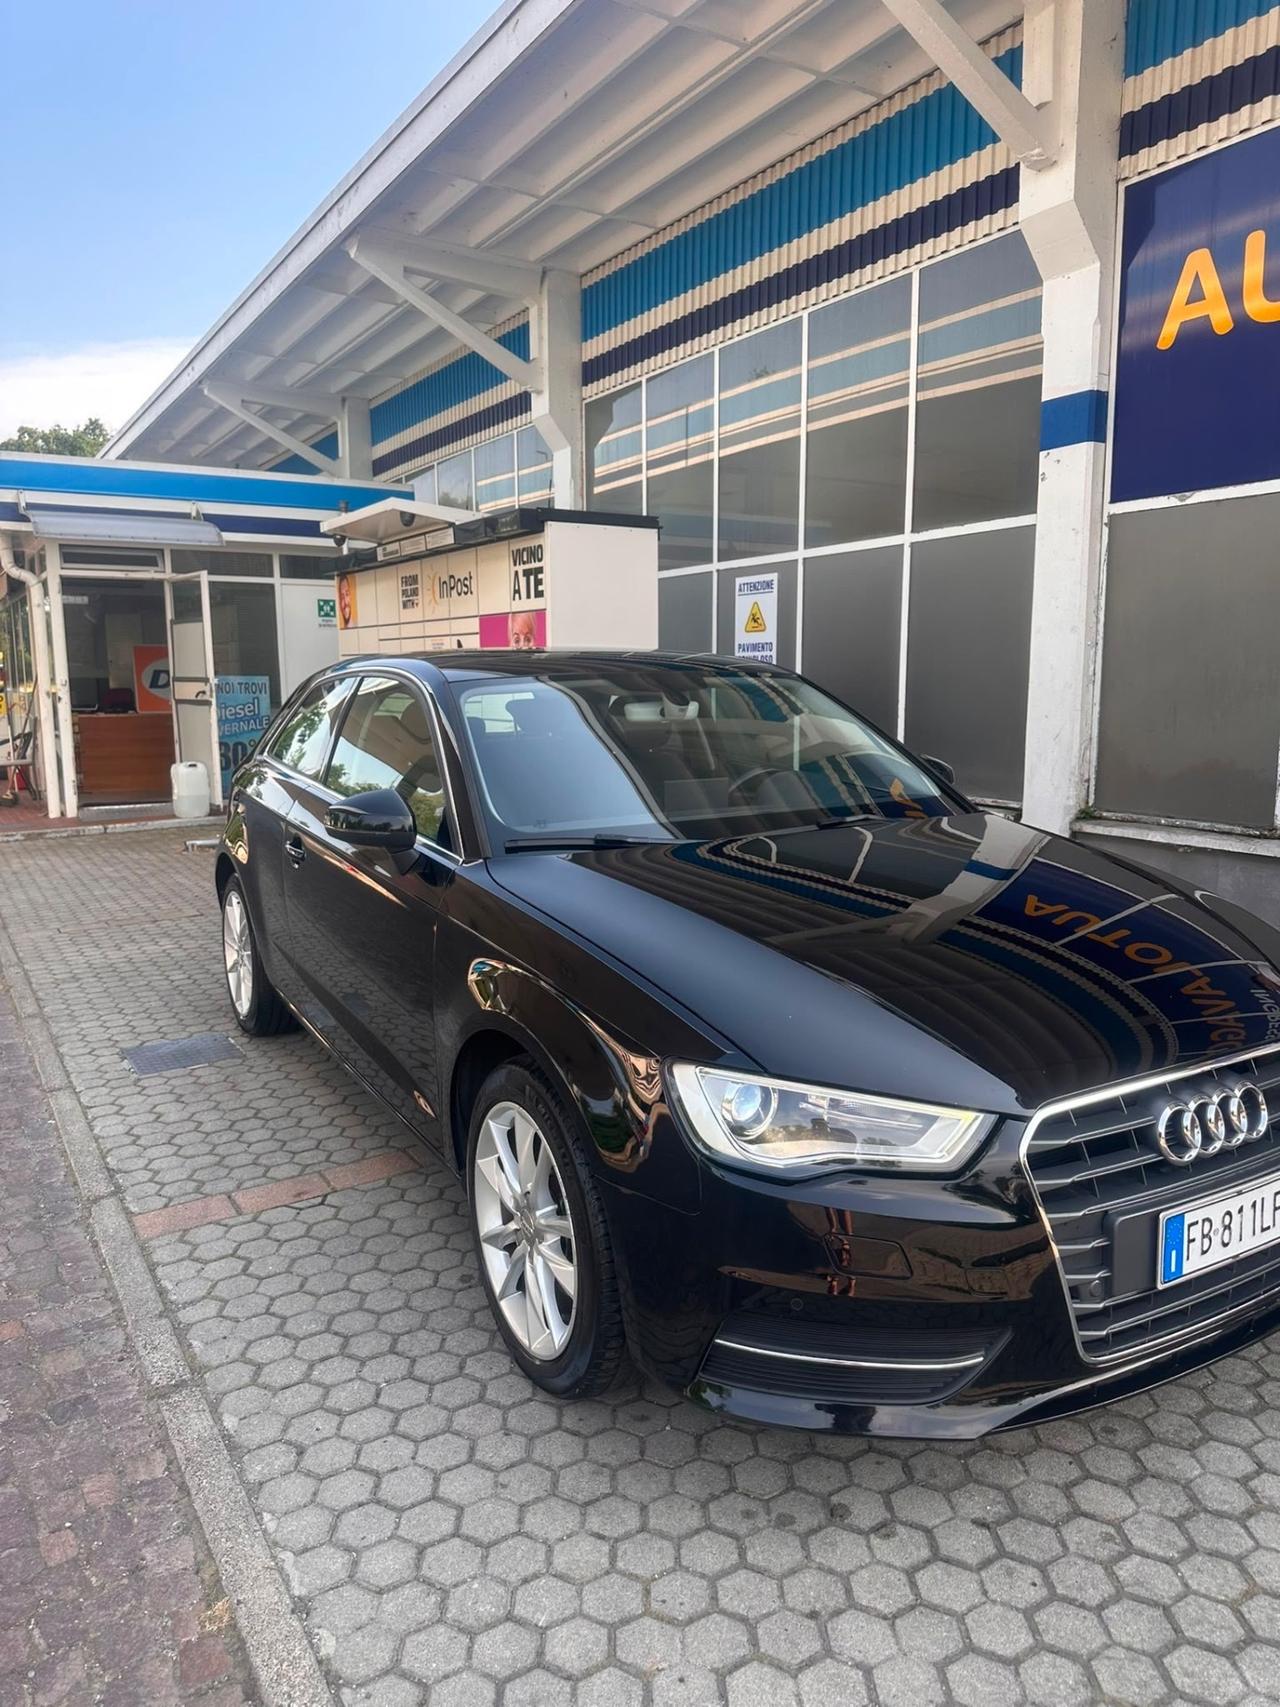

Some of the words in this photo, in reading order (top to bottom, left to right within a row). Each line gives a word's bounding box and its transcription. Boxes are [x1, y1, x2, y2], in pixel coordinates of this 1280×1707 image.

[511, 543, 544, 567] VICINO
[438, 571, 473, 599] InPost
[512, 570, 522, 601] A
[522, 566, 545, 600] TE
[738, 579, 774, 592] ATTENZIONE
[738, 642, 774, 653] PAVIMENTO
[237, 682, 268, 695] TROVI
[218, 698, 259, 721] iesel
